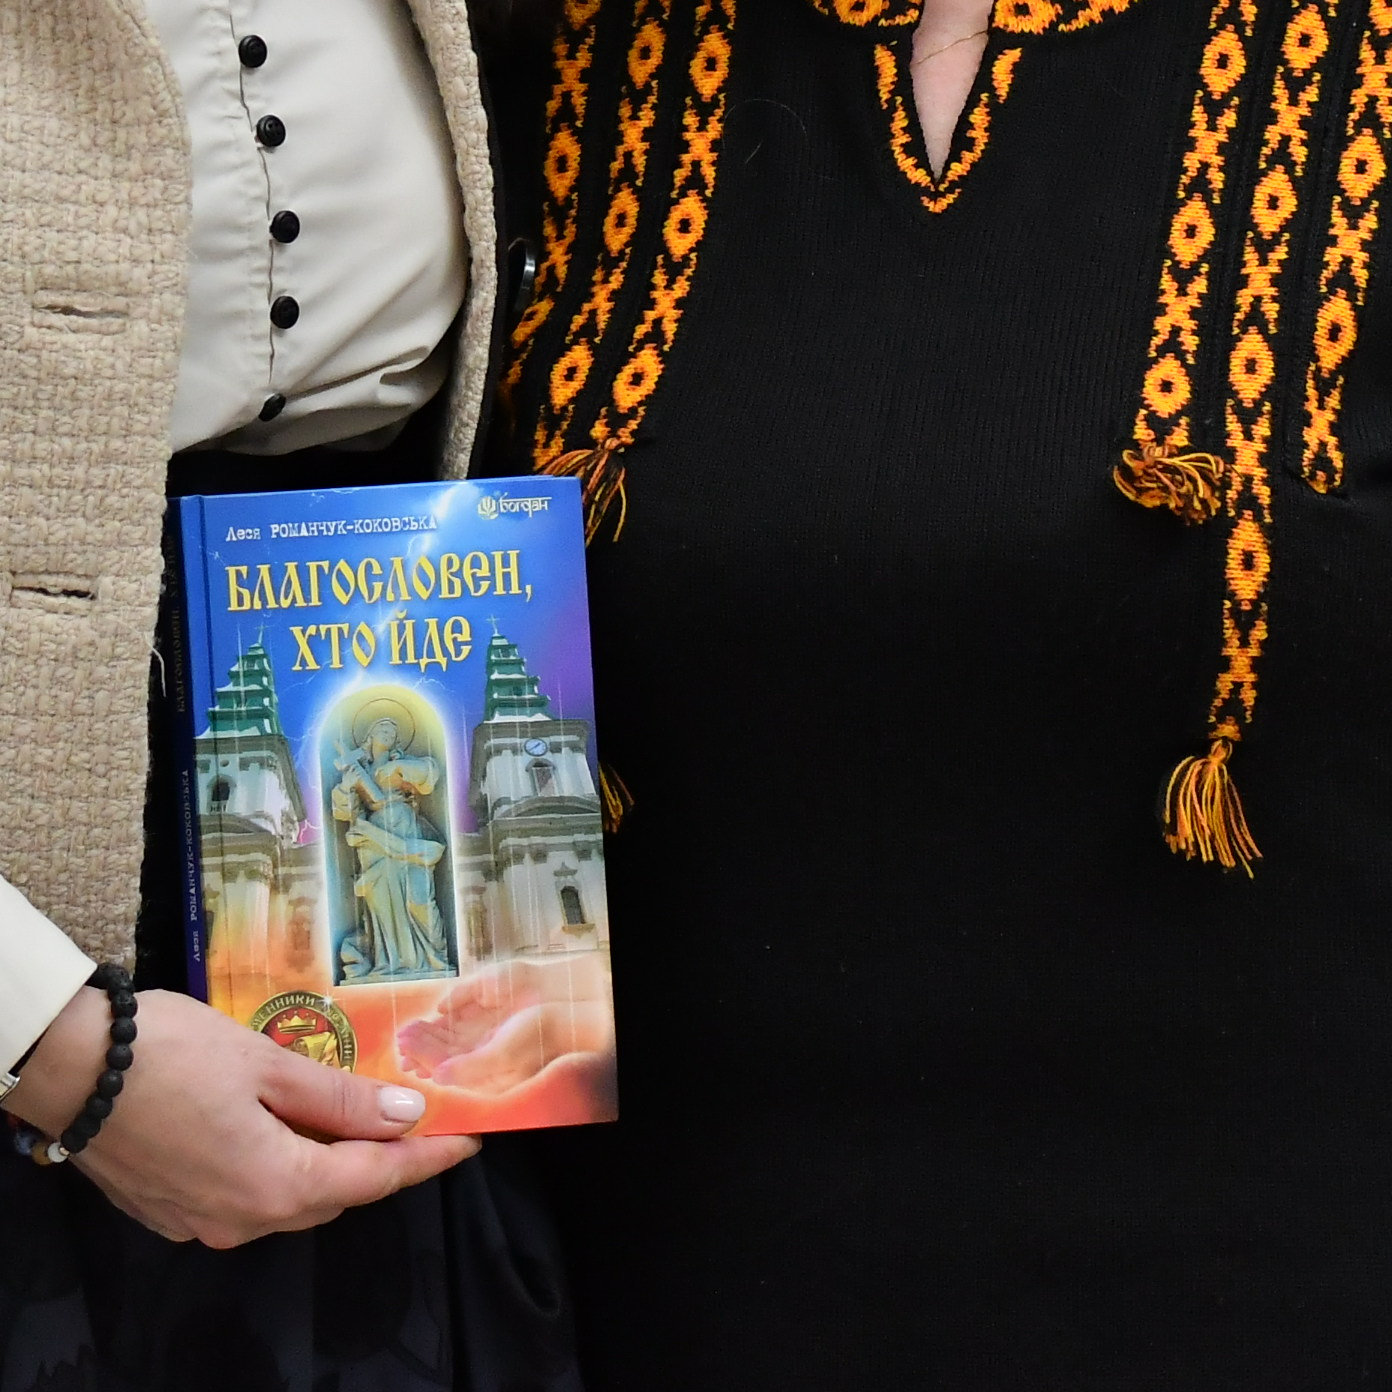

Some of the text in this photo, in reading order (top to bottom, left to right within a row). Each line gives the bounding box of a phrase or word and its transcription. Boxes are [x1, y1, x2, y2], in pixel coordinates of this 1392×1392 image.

[225, 514, 438, 542] Леся РОМАНЧУК-КОКОВСЬКА
[224, 549, 533, 612] БЛАГОСЛОВЕН,
[289, 608, 473, 673] ХТО ЙДЕ
